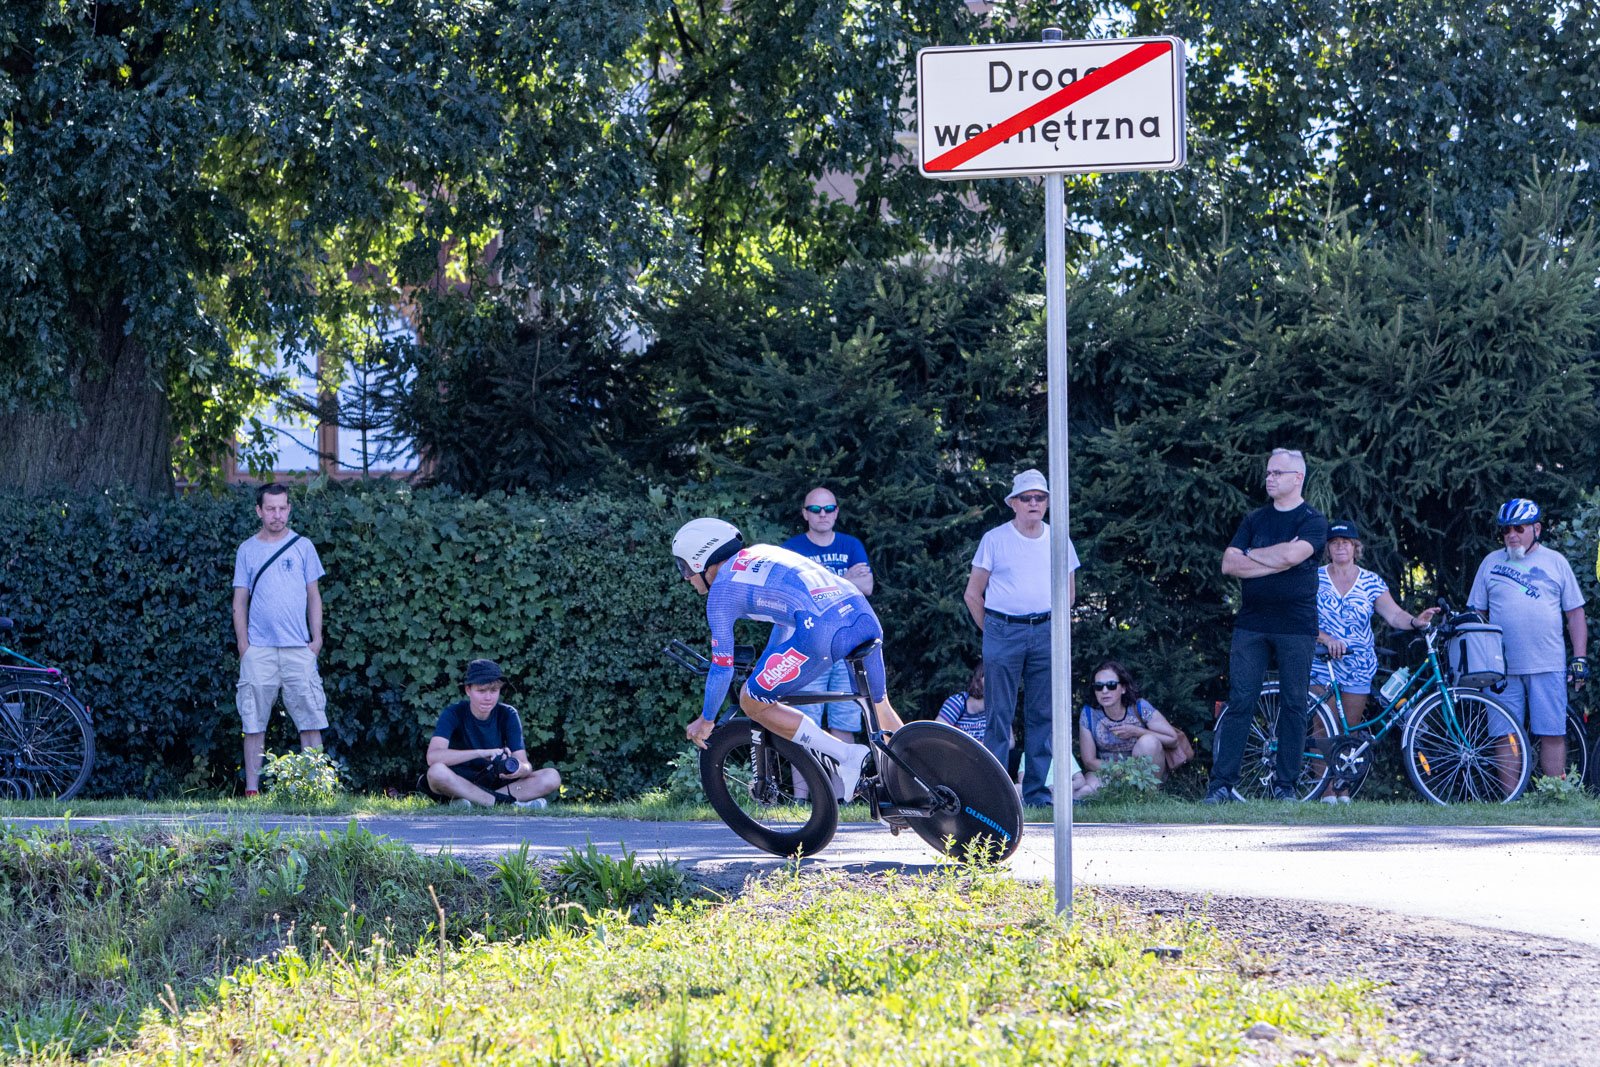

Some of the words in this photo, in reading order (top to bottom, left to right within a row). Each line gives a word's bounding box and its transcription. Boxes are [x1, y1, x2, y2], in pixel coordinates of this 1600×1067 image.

[692, 537, 719, 560] CANYON
[812, 591, 842, 602] SOUDAL
[762, 655, 798, 685] Alpecin
[750, 746, 758, 784] CANYON
[965, 806, 1011, 841] SHIMANO
